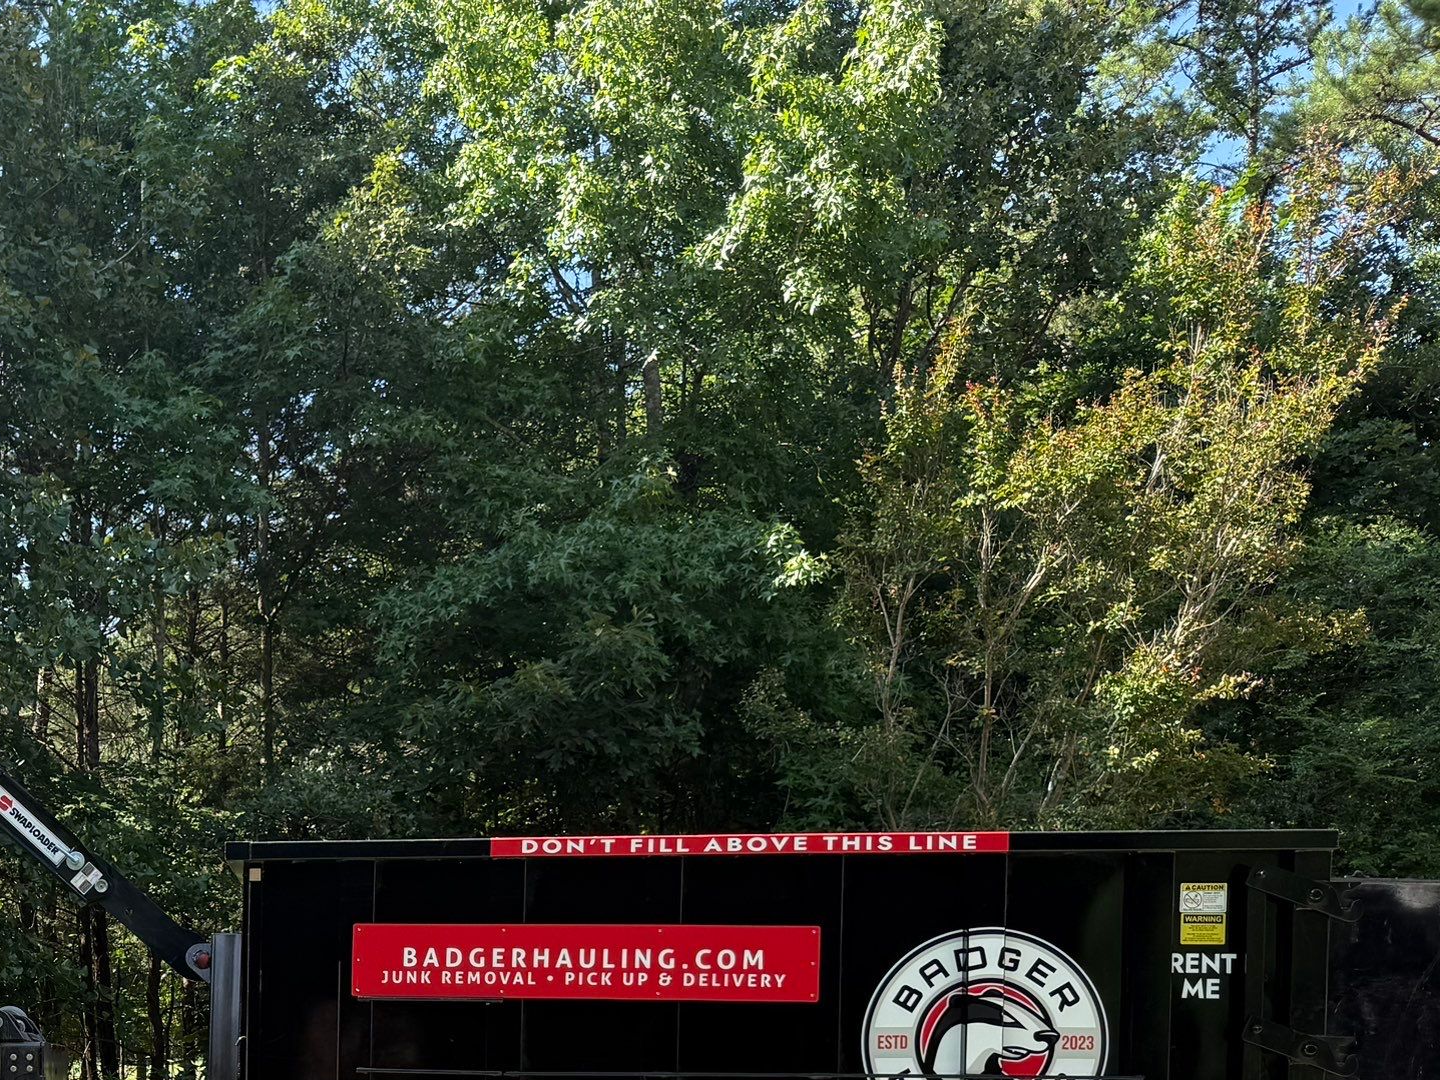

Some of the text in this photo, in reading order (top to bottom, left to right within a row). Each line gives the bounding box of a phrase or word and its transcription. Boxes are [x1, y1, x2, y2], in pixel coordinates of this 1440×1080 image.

[9, 807, 60, 855] SWAPLOADER
[521, 835, 977, 854] DON'T FILL ABOVE THIS LINE
[1185, 915, 1222, 923] WARNING
[403, 947, 764, 970] BADGERHAULING.COM
[1171, 952, 1237, 974] RENT
[381, 970, 786, 988] JUNK REMOVAL PICK UP & DELIVERY
[892, 946, 1080, 1013] BADGER
[1181, 978, 1220, 999] ME
[877, 1035, 908, 1050] ESTD
[1061, 1035, 1094, 1050] 2023
